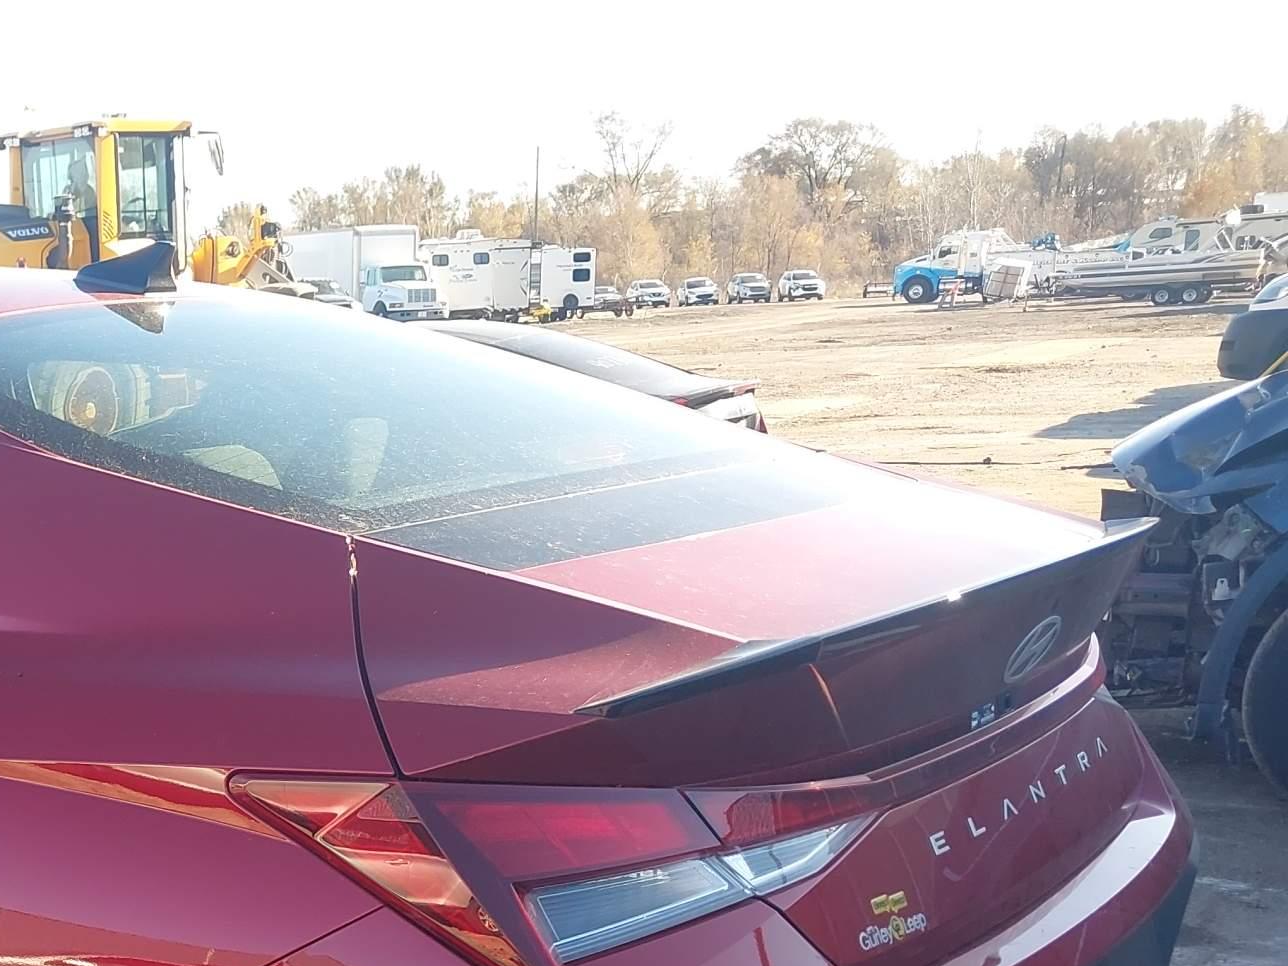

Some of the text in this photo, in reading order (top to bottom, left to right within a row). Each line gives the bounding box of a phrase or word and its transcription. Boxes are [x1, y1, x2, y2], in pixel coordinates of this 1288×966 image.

[7, 226, 49, 238] VOLVO
[929, 737, 1108, 856] ELANTRA
[901, 913, 927, 934] Leep
